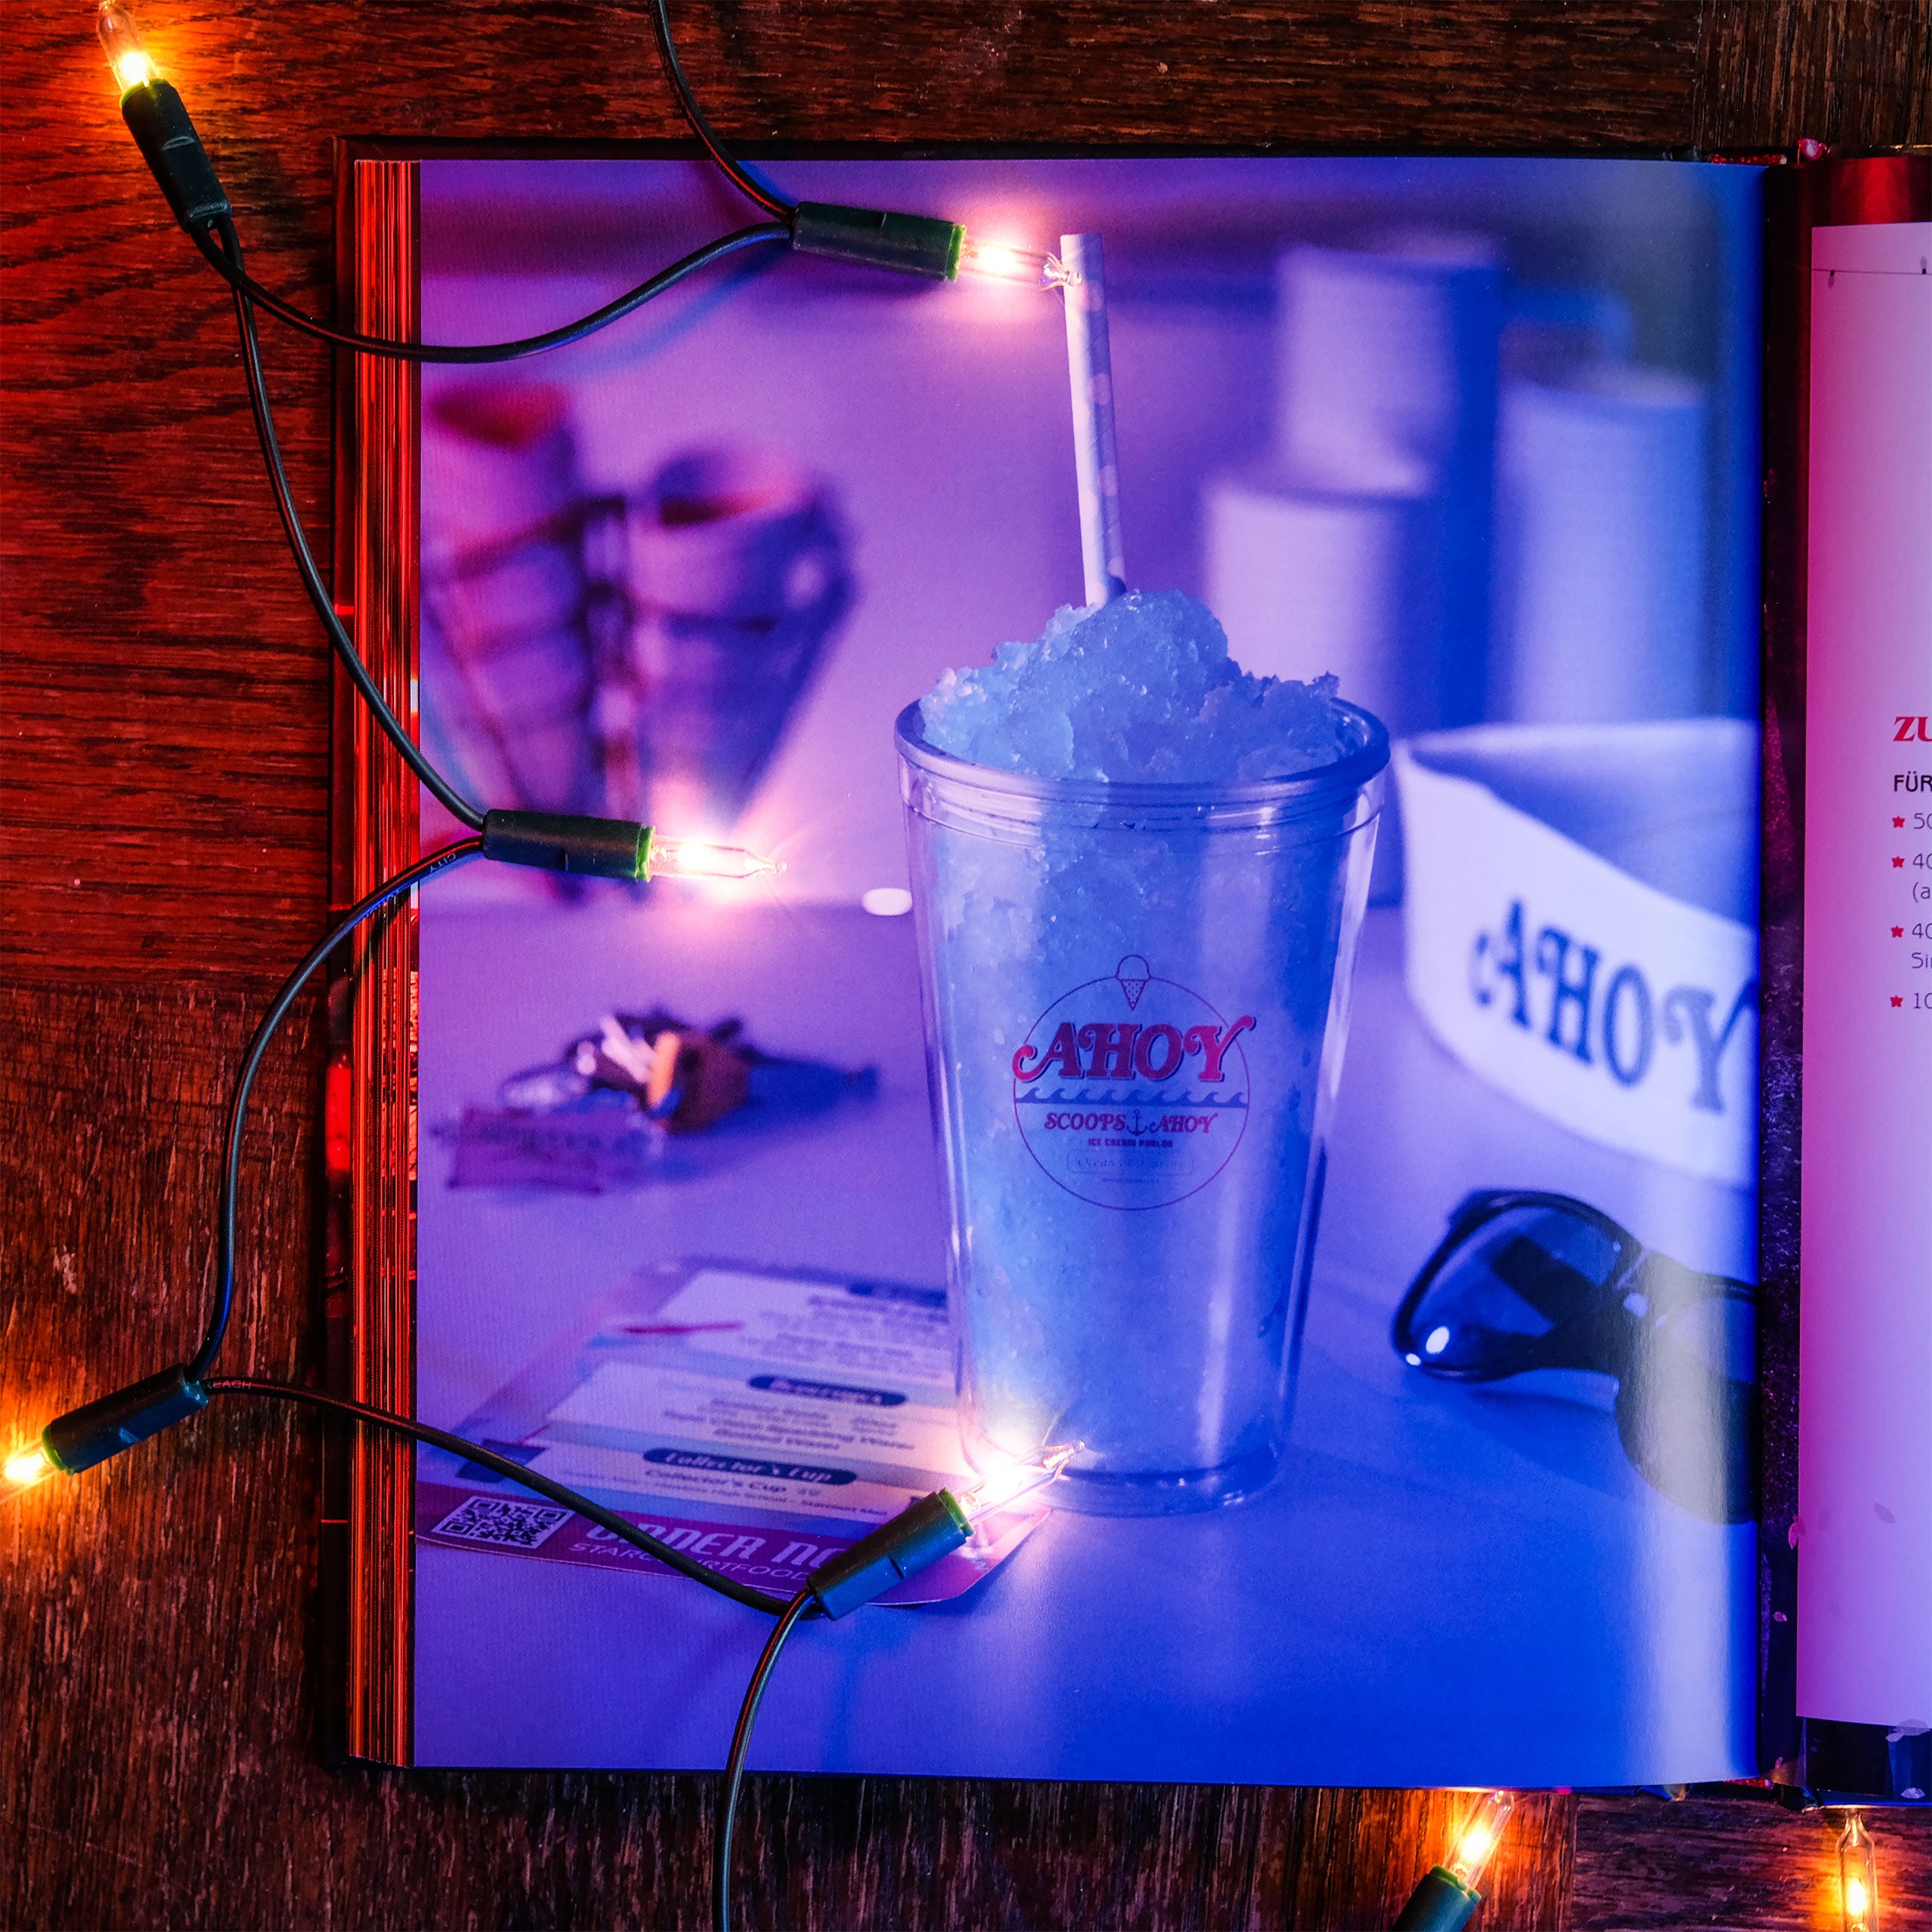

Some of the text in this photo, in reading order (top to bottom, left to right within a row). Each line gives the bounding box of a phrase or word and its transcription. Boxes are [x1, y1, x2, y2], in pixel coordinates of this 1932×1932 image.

[1894, 771, 1932, 792] FÜR
[1911, 952, 1932, 969] Si
[1467, 898, 1761, 1118] AHOY
[1012, 1015, 1257, 1083] AHOY
[1044, 1112, 1219, 1134] SCOOPS AHOY
